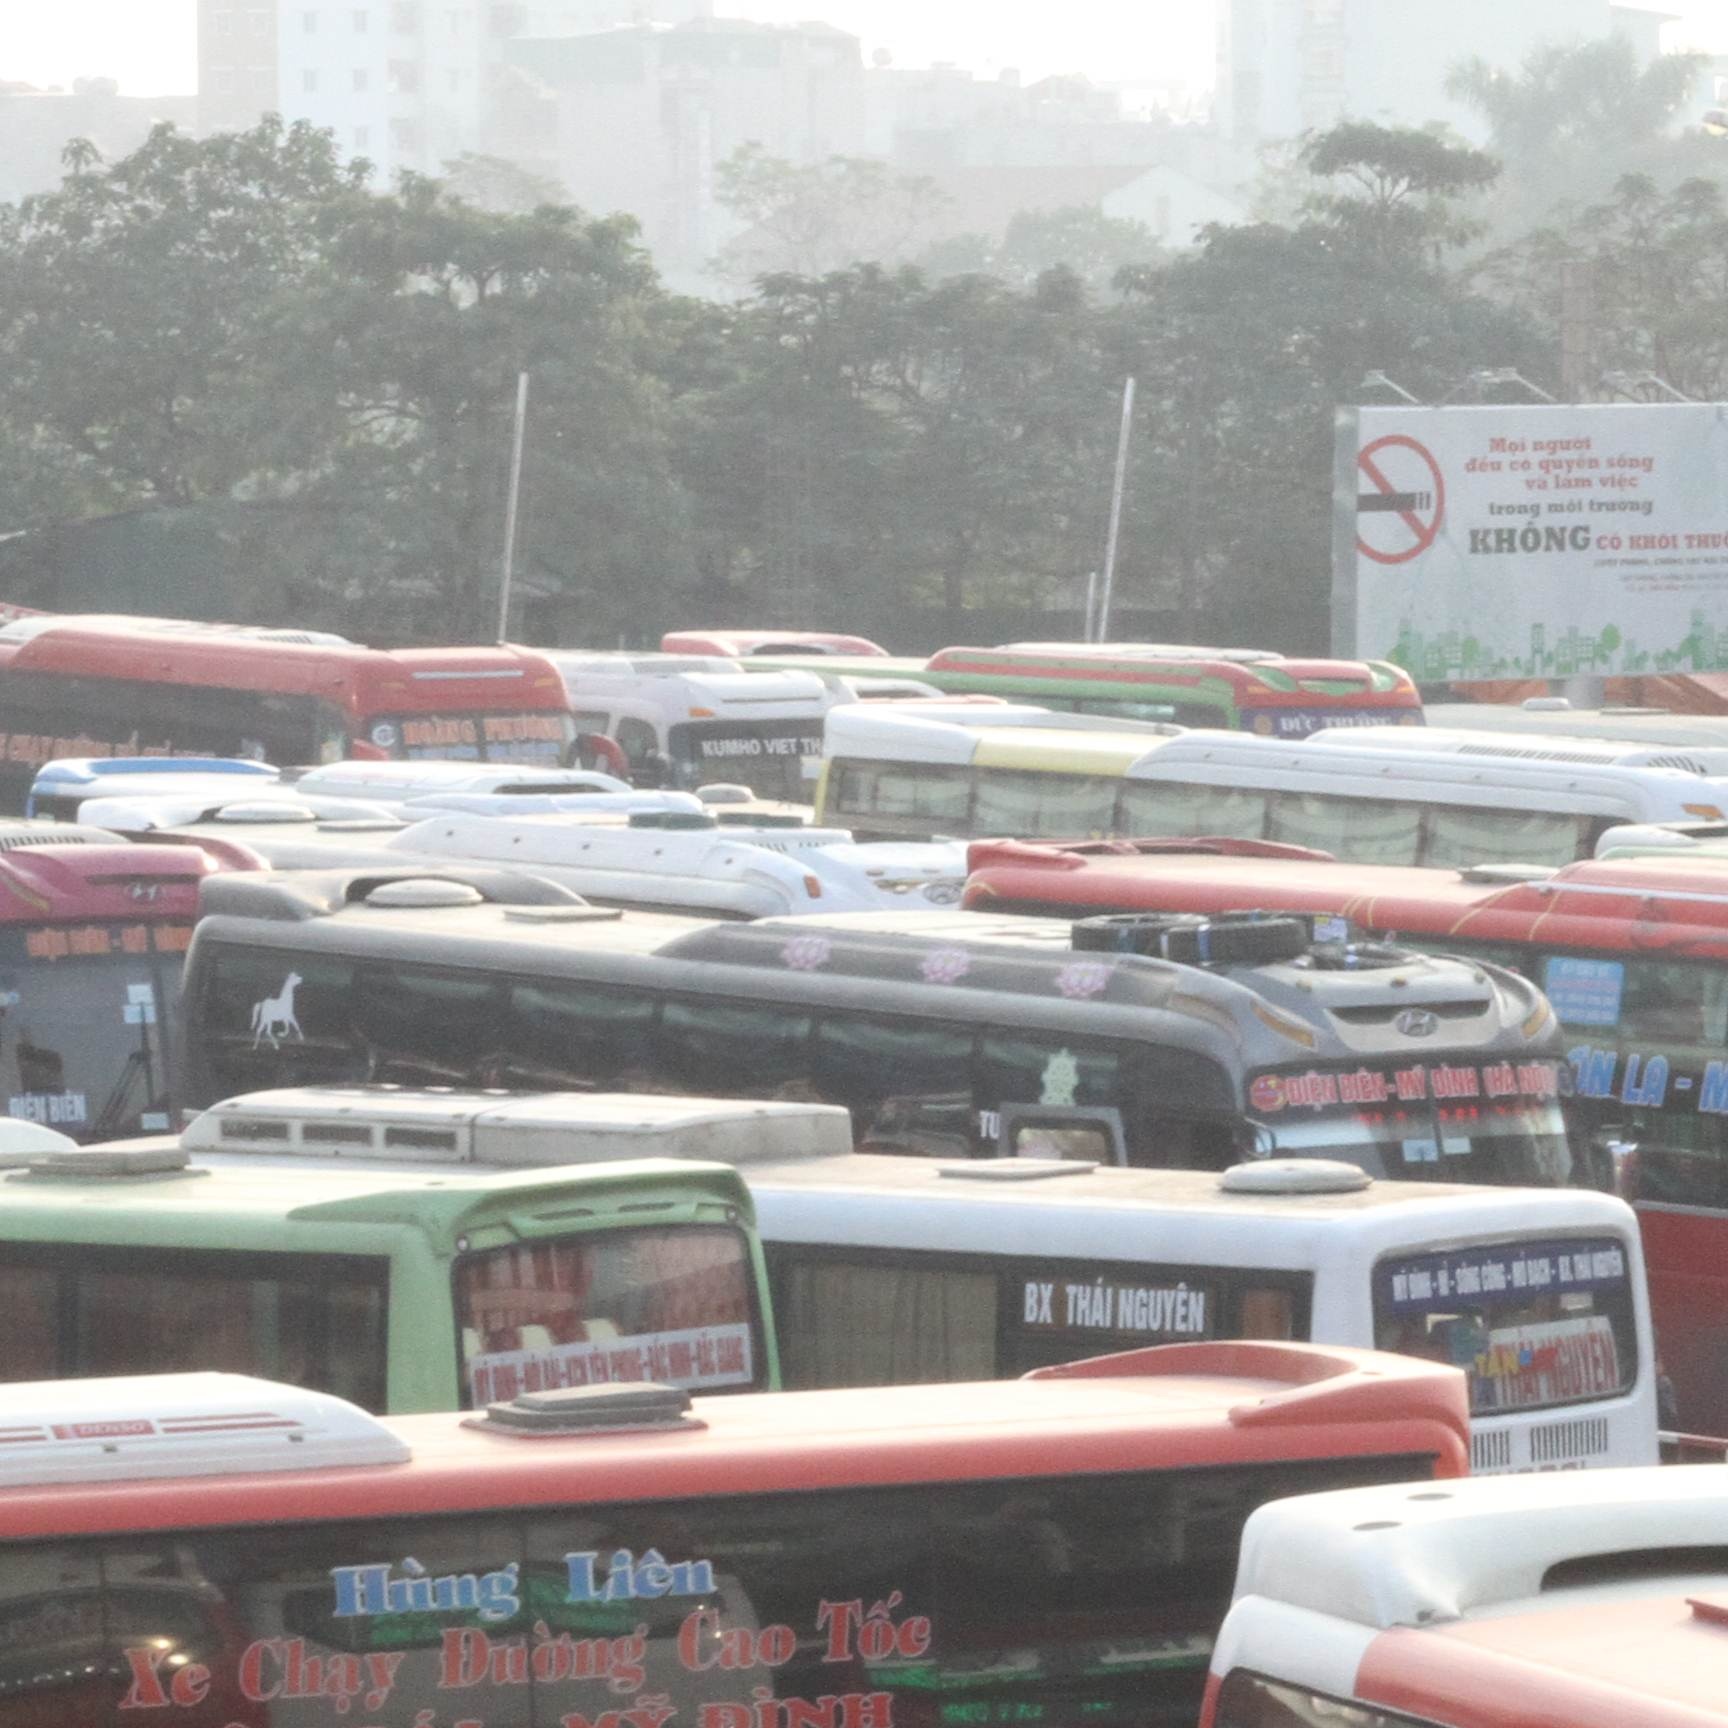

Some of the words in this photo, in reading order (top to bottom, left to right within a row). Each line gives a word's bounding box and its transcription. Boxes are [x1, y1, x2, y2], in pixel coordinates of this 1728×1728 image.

[1488, 500, 1541, 519] trong
[1468, 521, 1592, 555] KHÔNG
[701, 738, 762, 759] KUMHO
[763, 737, 798, 756] VIET
[1620, 1053, 1670, 1108] LA
[1024, 1281, 1054, 1324] BX
[1065, 1276, 1114, 1329] THÁI
[1118, 1282, 1206, 1333] NGUYÊN
[330, 1555, 521, 1621] Hùng
[565, 1547, 719, 1605] Liên
[119, 1645, 212, 1710] Xe
[239, 1636, 408, 1714] Chạy
[437, 1618, 650, 1693] Đường
[677, 1605, 798, 1672] Cao
[816, 1589, 932, 1663] Tốc
